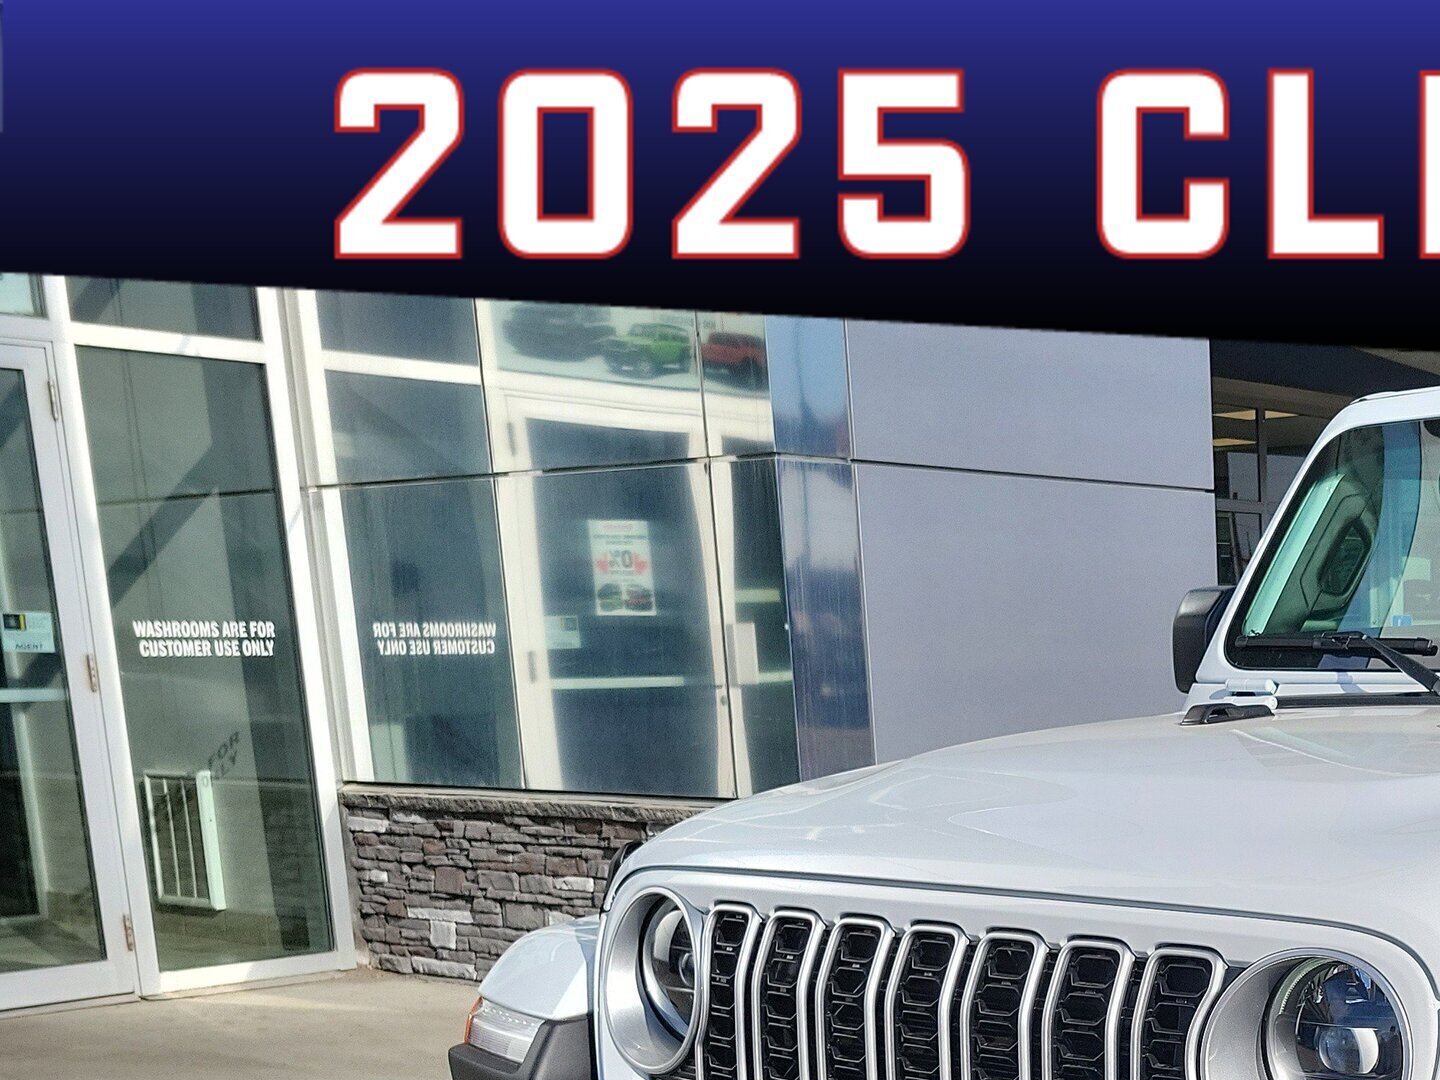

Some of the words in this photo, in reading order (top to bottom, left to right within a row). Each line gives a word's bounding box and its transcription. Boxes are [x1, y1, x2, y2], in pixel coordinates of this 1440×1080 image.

[132, 619, 219, 638] WASHROOMS
[222, 620, 248, 638] ARE
[249, 620, 276, 638] FOR
[139, 639, 213, 658] CUSTOMER
[214, 639, 241, 657] USE
[242, 639, 275, 657] ONLY
